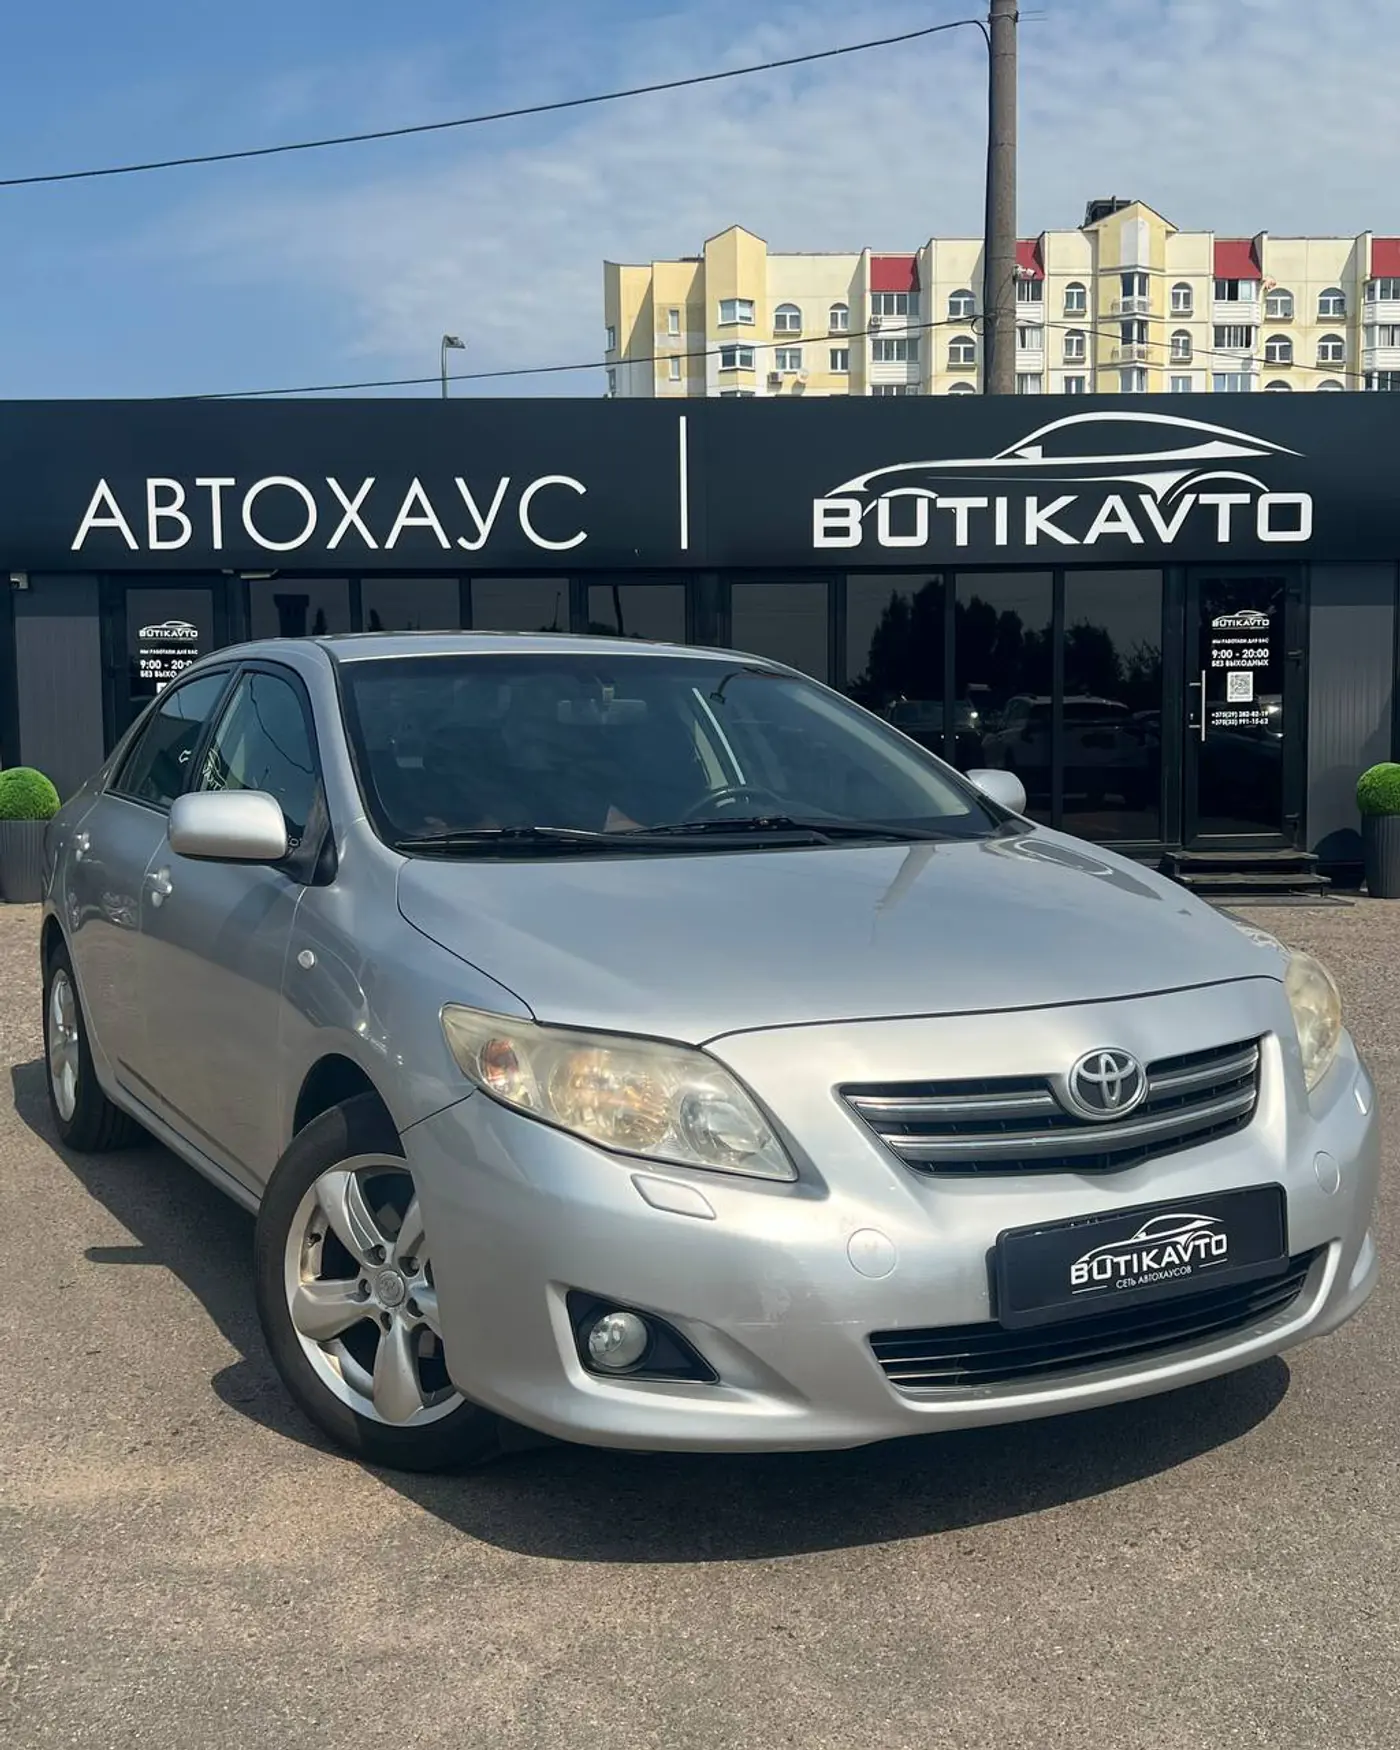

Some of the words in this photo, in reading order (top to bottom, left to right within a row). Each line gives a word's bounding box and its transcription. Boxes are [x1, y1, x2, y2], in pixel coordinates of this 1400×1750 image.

[71, 475, 587, 550] АВТОХАУС
[812, 491, 1312, 548] BUTIKAVTO
[140, 659, 162, 670] 9:00
[1211, 649, 1233, 659] 9:00
[1242, 648, 1269, 658] 20:00
[1071, 1233, 1228, 1285] BUTIKAVTO
[1115, 1277, 1137, 1289] СЕТЬ
[1137, 1265, 1193, 1285] АВТОХАУСОВ
